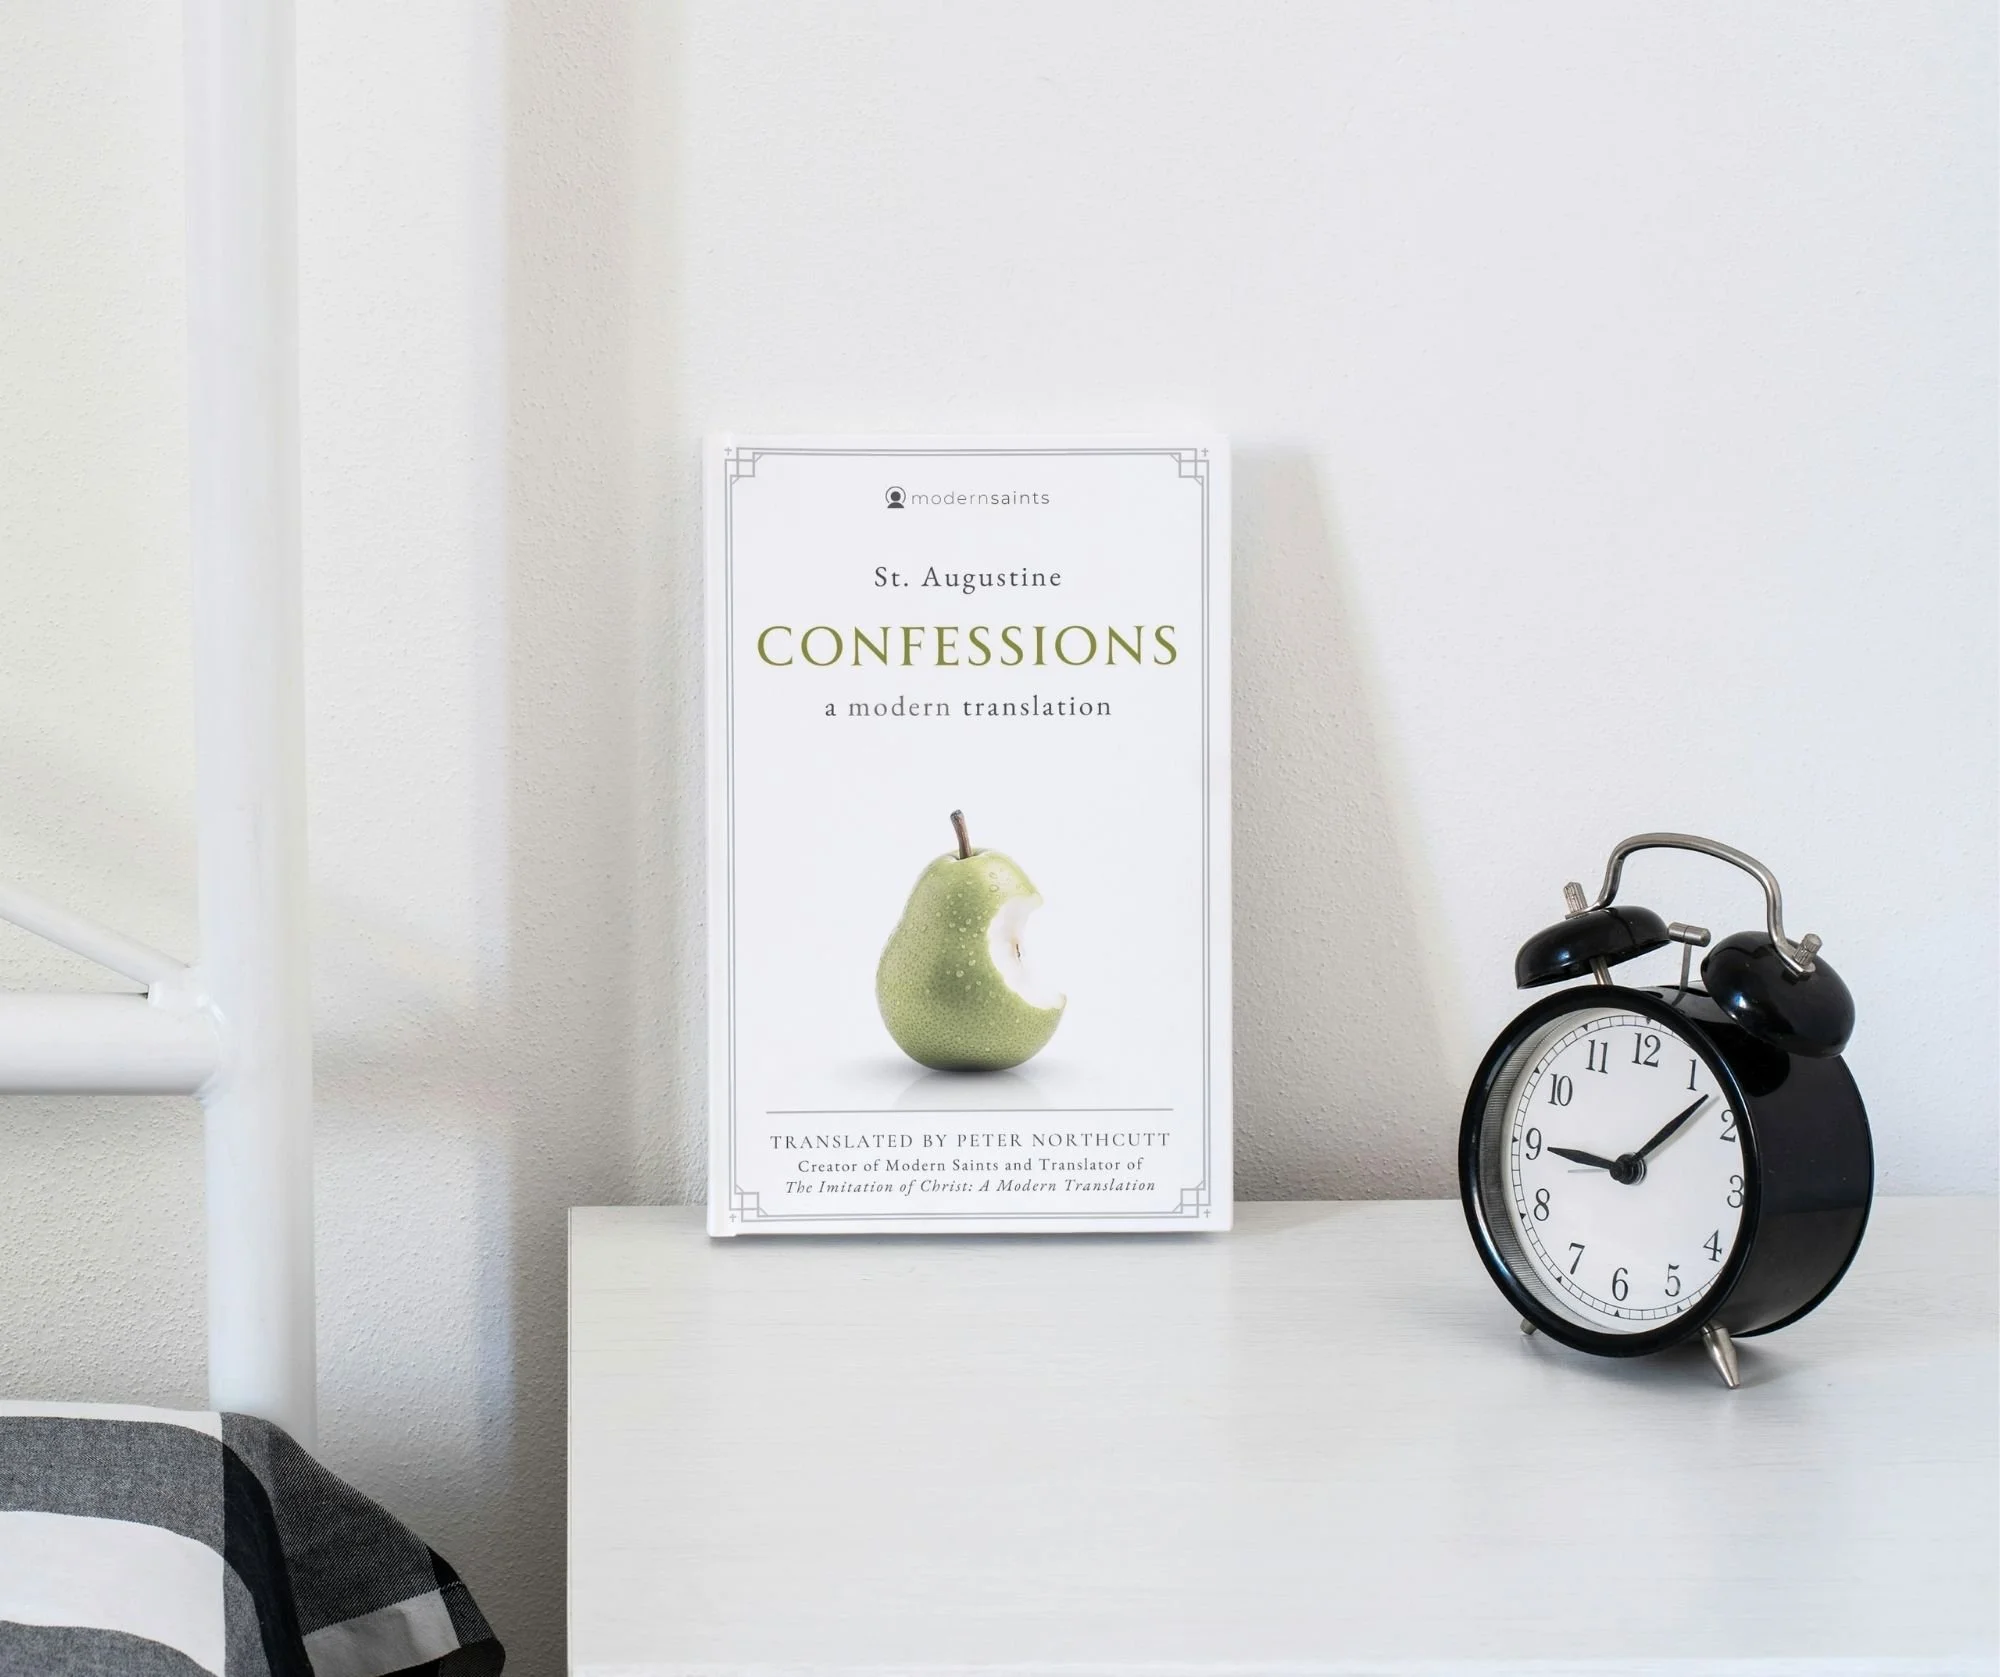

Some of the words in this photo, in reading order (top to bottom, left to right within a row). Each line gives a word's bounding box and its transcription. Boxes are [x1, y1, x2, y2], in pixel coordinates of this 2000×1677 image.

[911, 487, 1050, 506] modernsaints
[874, 566, 909, 588] St.
[921, 566, 1062, 595] Augustine
[757, 624, 1178, 667] CONFESSIONS
[825, 703, 837, 717] a
[848, 695, 951, 717] modern
[963, 694, 1112, 717] translation
[1585, 1039, 1609, 1074] 11
[1632, 1033, 1661, 1067] 12
[1547, 1073, 1573, 1107] 10
[1686, 1059, 1697, 1091] 1
[769, 1133, 913, 1150] TRANSLATED
[923, 1133, 947, 1148] BY
[957, 1133, 1023, 1148] PETER
[1032, 1132, 1171, 1147] NORTHCUTT
[1720, 1109, 1736, 1143] 2
[1526, 1128, 1542, 1160] 9
[798, 1159, 858, 1173] Creator
[863, 1158, 880, 1172] of
[885, 1158, 946, 1172] Modern
[952, 1158, 999, 1171] Saints
[1004, 1157, 1032, 1171] and
[1038, 1157, 1121, 1171] Translator
[1126, 1156, 1145, 1170] of
[786, 1180, 814, 1194] The
[819, 1180, 893, 1193] Imitation
[899, 1179, 917, 1197] of
[920, 1178, 974, 1192] Christ:
[979, 1179, 991, 1192] A
[996, 1178, 1057, 1192] Modern
[1064, 1177, 1155, 1192] Translation
[1726, 1175, 1744, 1208] 3
[1533, 1188, 1550, 1221] 8
[1568, 1242, 1585, 1275] 7
[1703, 1229, 1722, 1263] 4
[1611, 1267, 1629, 1301] 6
[1665, 1263, 1681, 1297] 5
